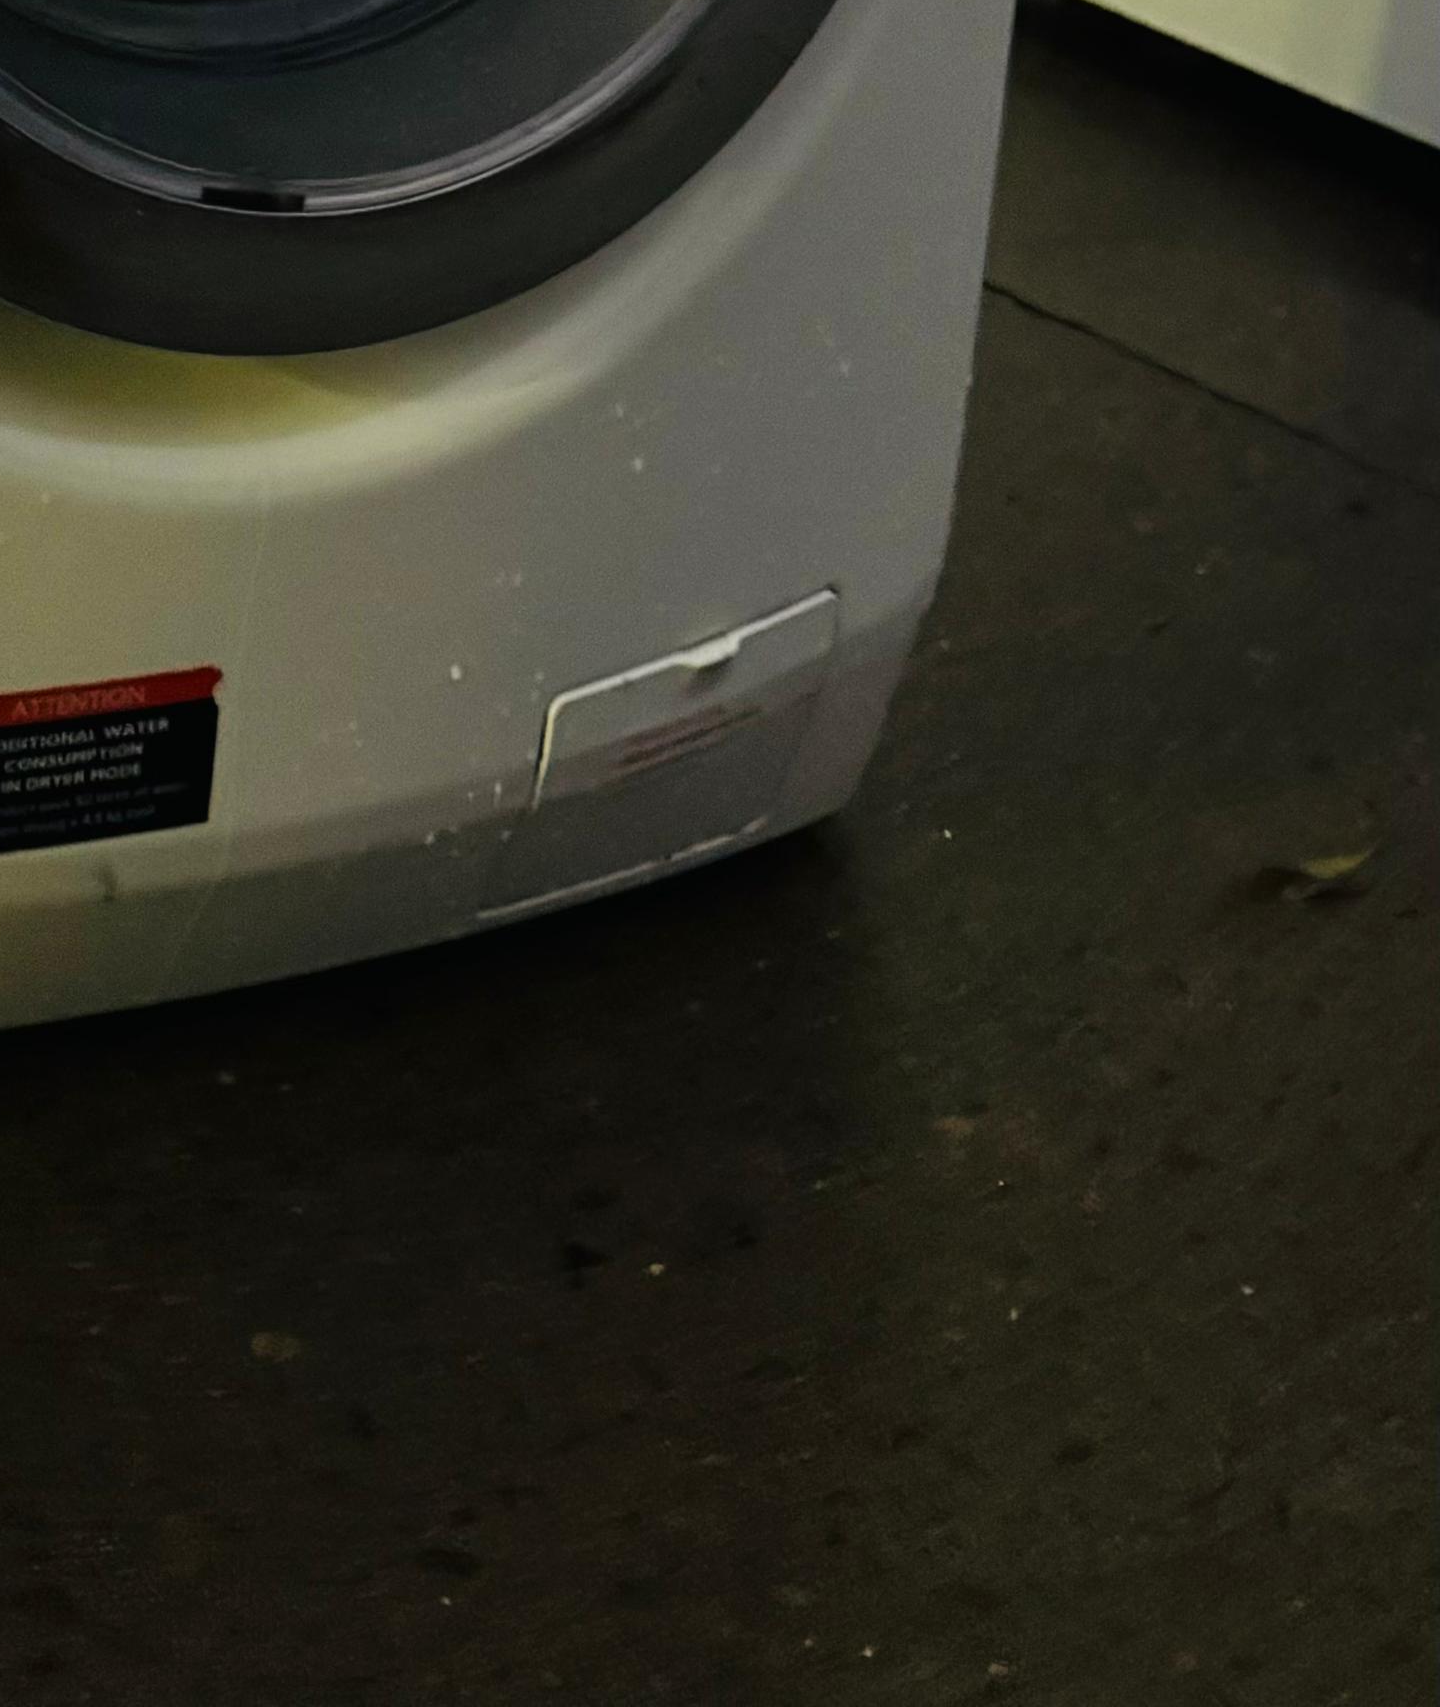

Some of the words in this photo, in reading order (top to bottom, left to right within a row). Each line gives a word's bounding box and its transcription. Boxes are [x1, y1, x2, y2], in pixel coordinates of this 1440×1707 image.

[9, 686, 146, 720] ATTENTION
[103, 717, 170, 738] WATER
[4, 743, 144, 774] CONSUMPTION
[0, 779, 22, 795] IN
[25, 773, 86, 793] DRYER
[90, 762, 142, 782] MODE
